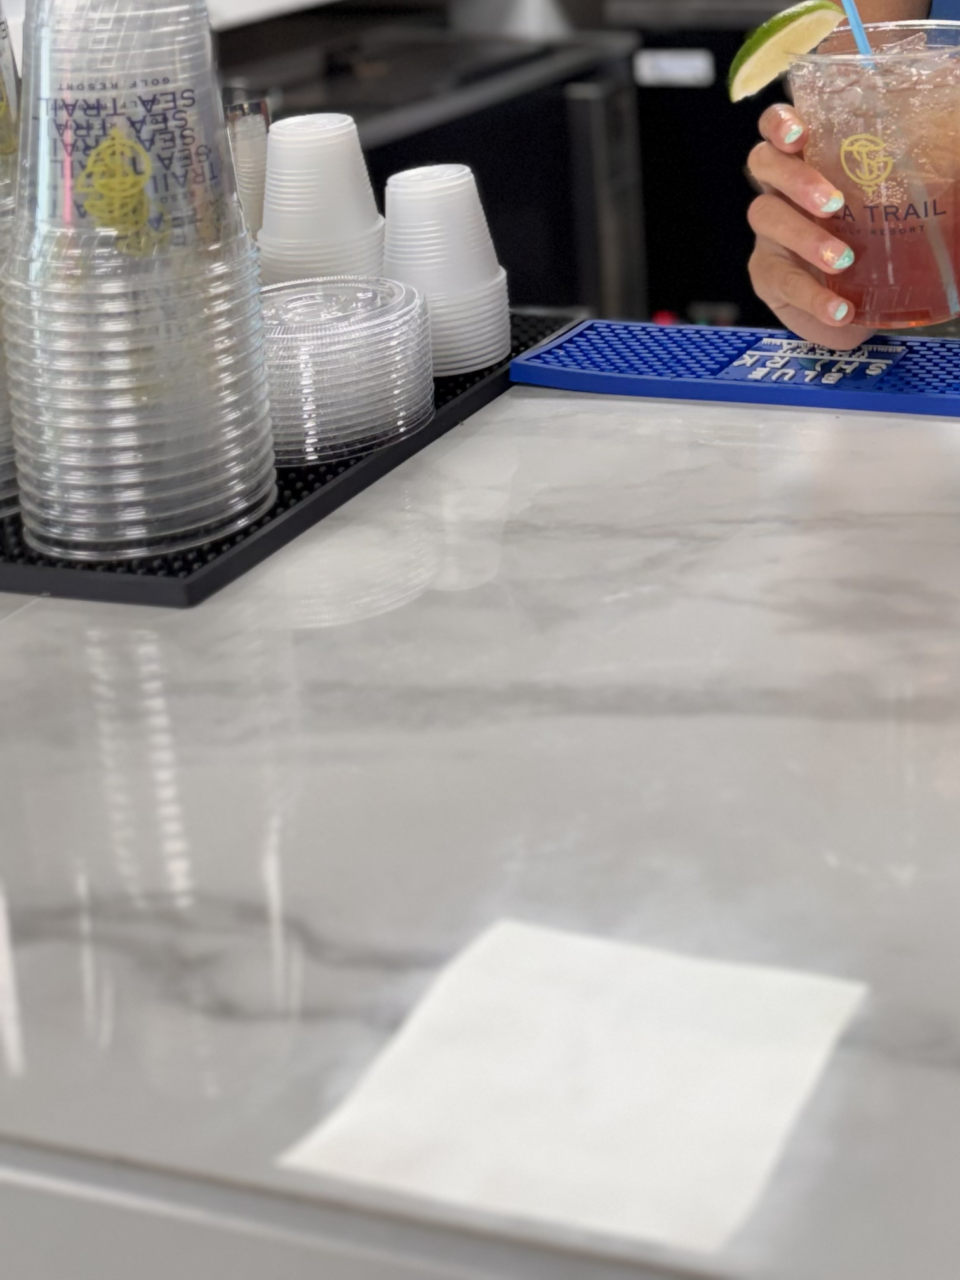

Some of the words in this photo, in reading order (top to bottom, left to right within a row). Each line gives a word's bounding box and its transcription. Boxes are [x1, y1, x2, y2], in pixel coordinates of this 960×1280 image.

[57, 81, 119, 92] RESORT
[138, 88, 196, 114] SEA
[863, 199, 947, 223] TRAIL
[870, 224, 925, 236] RESORT
[747, 367, 844, 384] BLUE
